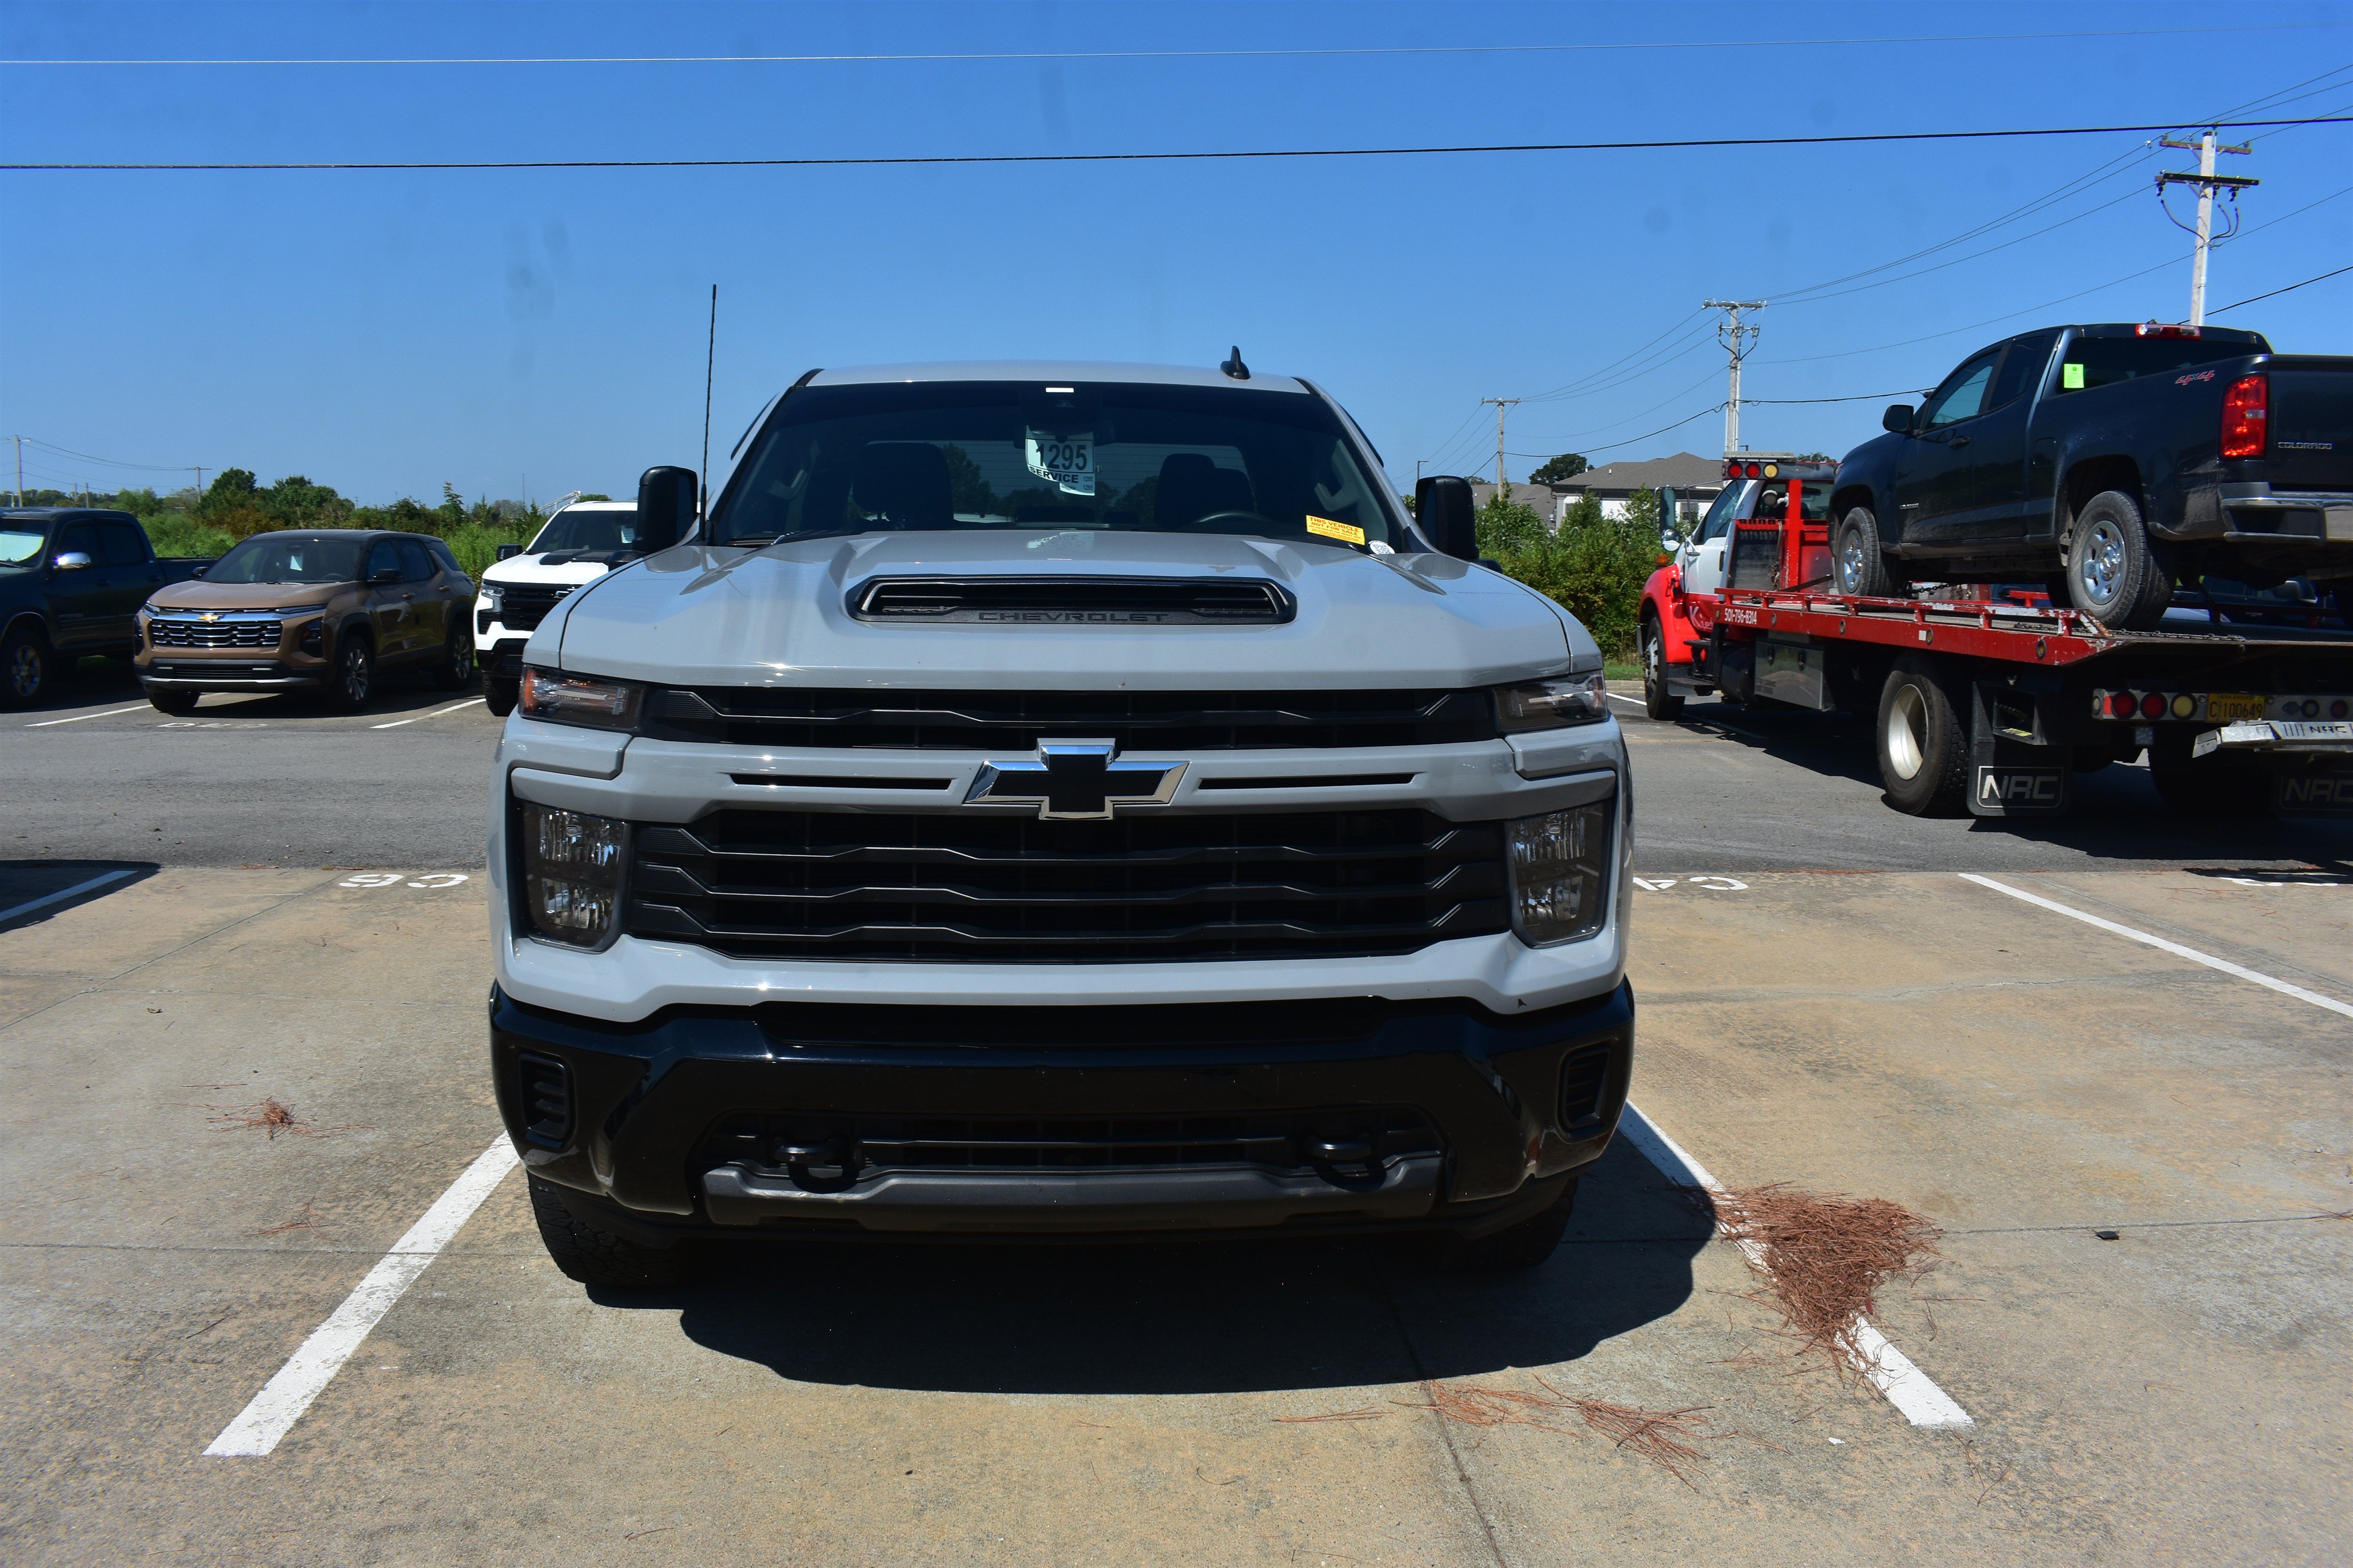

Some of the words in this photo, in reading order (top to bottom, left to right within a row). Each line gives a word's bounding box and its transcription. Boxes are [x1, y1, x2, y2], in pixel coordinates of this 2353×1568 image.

[2278, 442, 2332, 450] COLORADO
[1036, 443, 1087, 471] 1295
[1029, 466, 1079, 484] SERVICE
[1328, 522, 1359, 533] VEHICLE
[978, 612, 1168, 622] CHEVROLET
[1725, 608, 1757, 625] 501-796-8314
[2309, 725, 2347, 733] NRC
[1982, 775, 2059, 800] NRC
[2284, 778, 2353, 803] NRC
